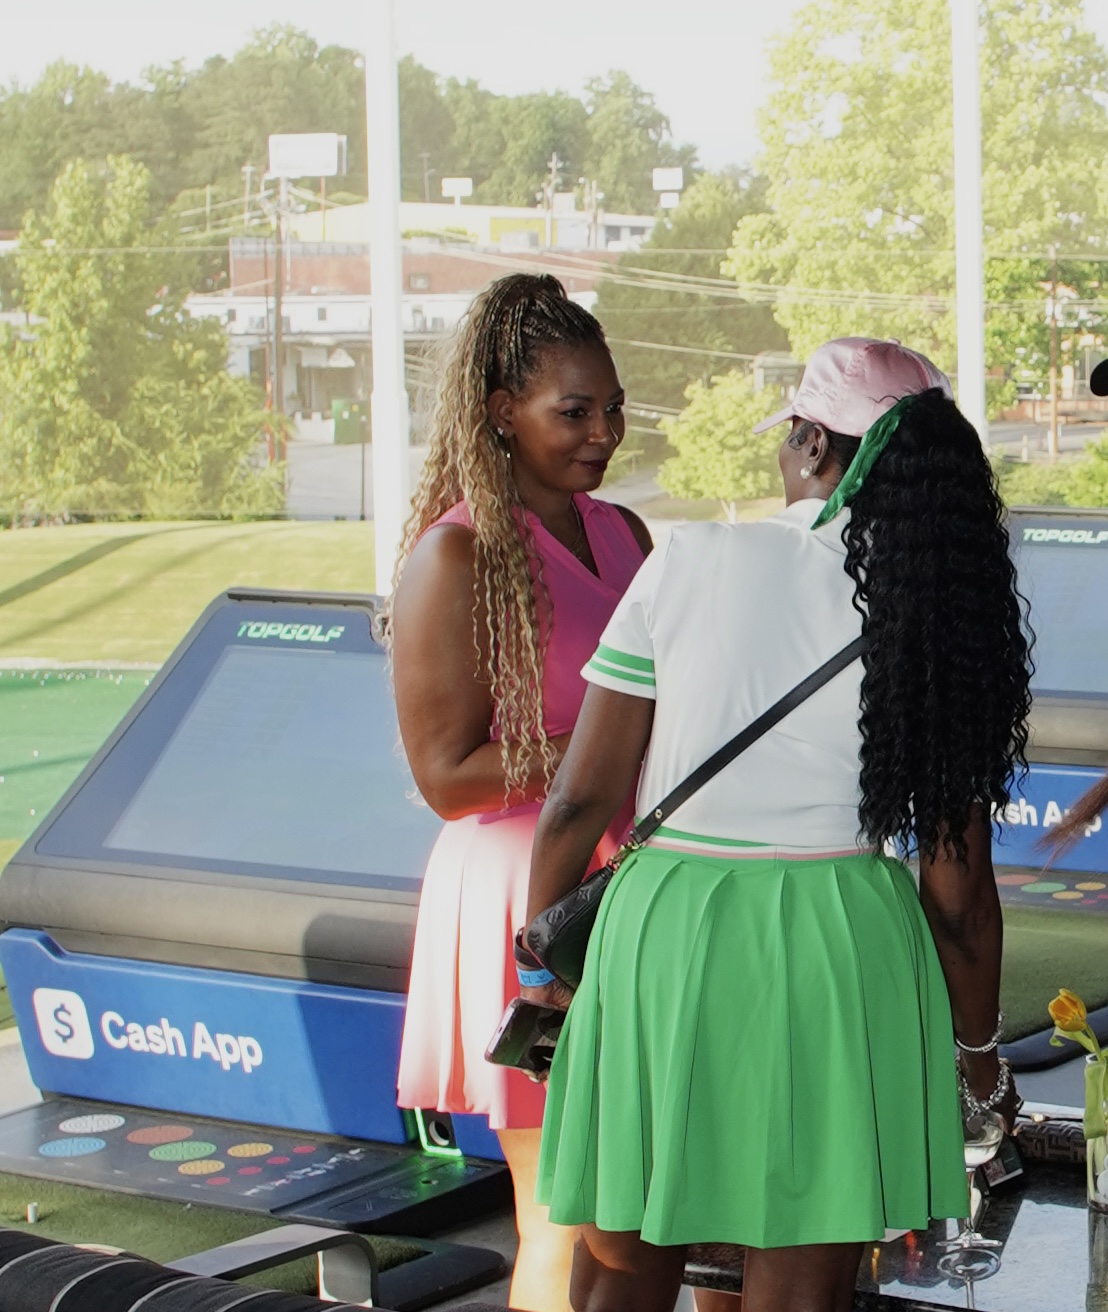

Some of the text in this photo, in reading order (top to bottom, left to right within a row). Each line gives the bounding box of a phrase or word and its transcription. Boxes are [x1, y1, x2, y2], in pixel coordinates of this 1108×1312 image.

[236, 620, 346, 642] TOPGOLF
[100, 1010, 188, 1058] Cash
[192, 1022, 263, 1073] App
